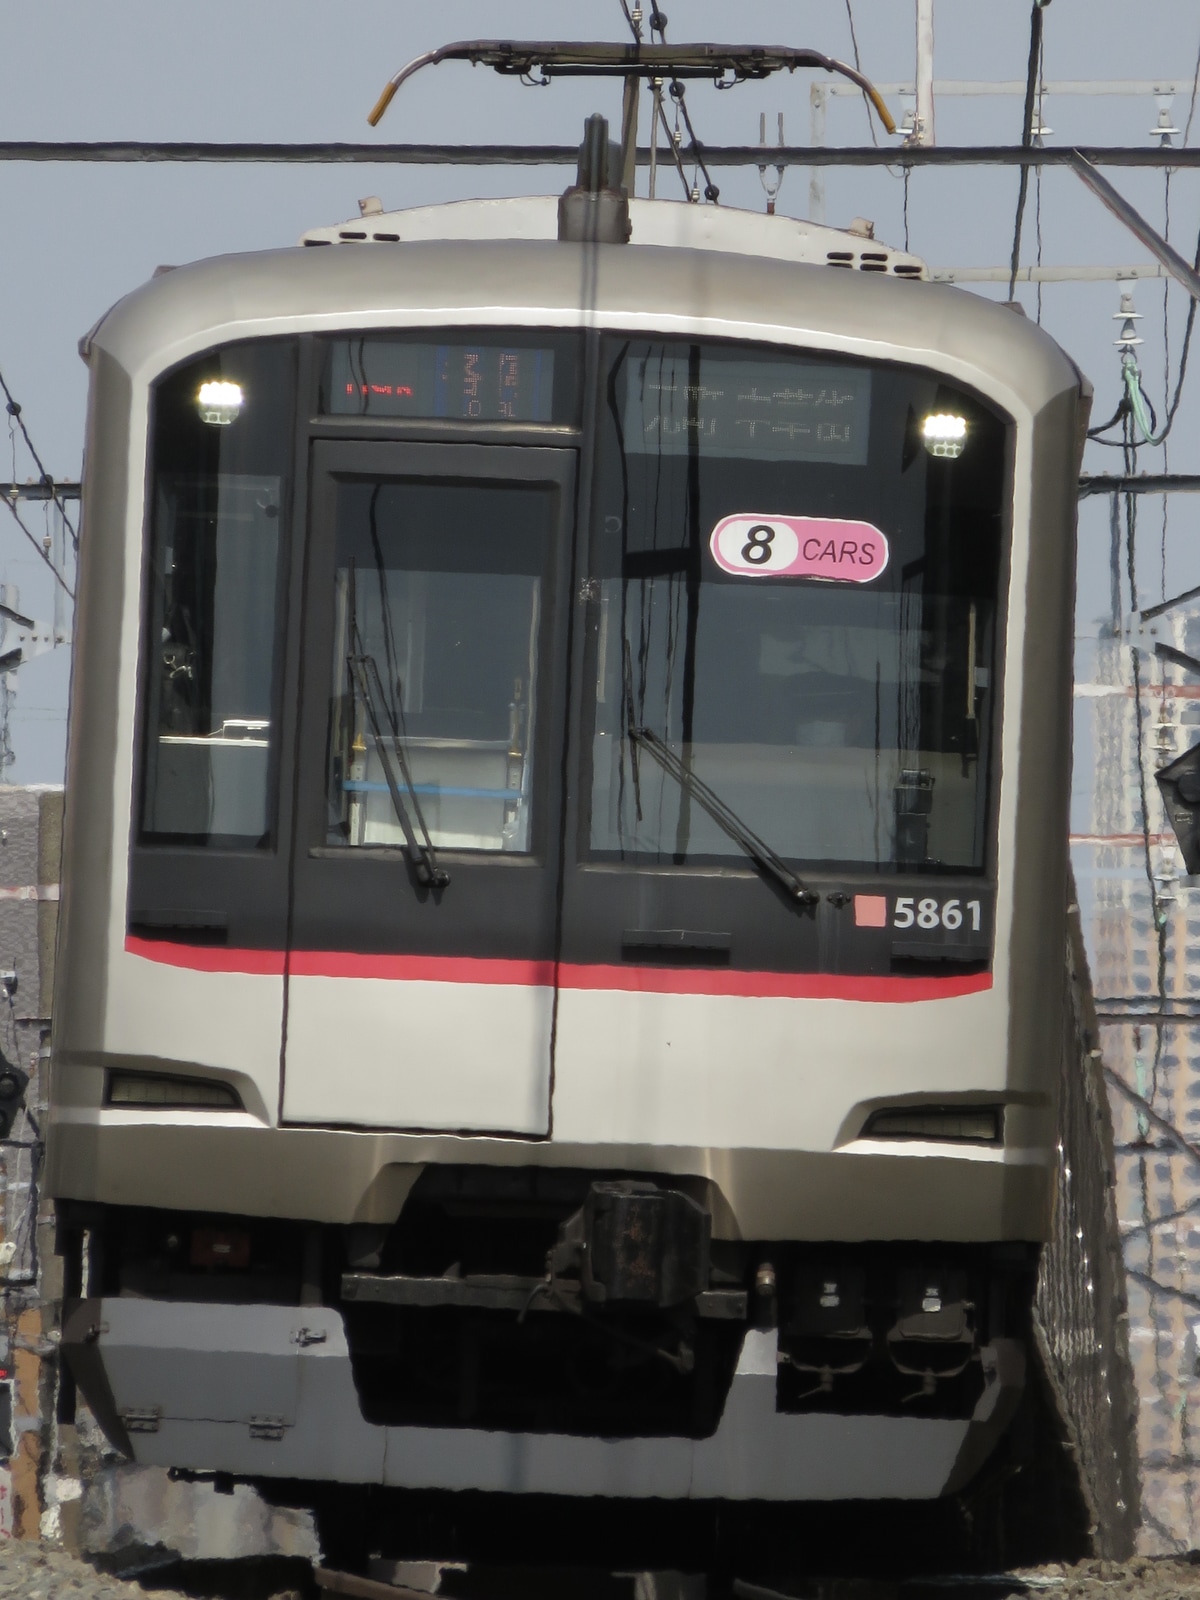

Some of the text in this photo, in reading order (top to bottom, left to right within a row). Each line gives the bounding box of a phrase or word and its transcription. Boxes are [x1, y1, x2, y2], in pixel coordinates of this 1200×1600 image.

[741, 525, 875, 565] 8 CARS
[893, 897, 981, 931] 5861
